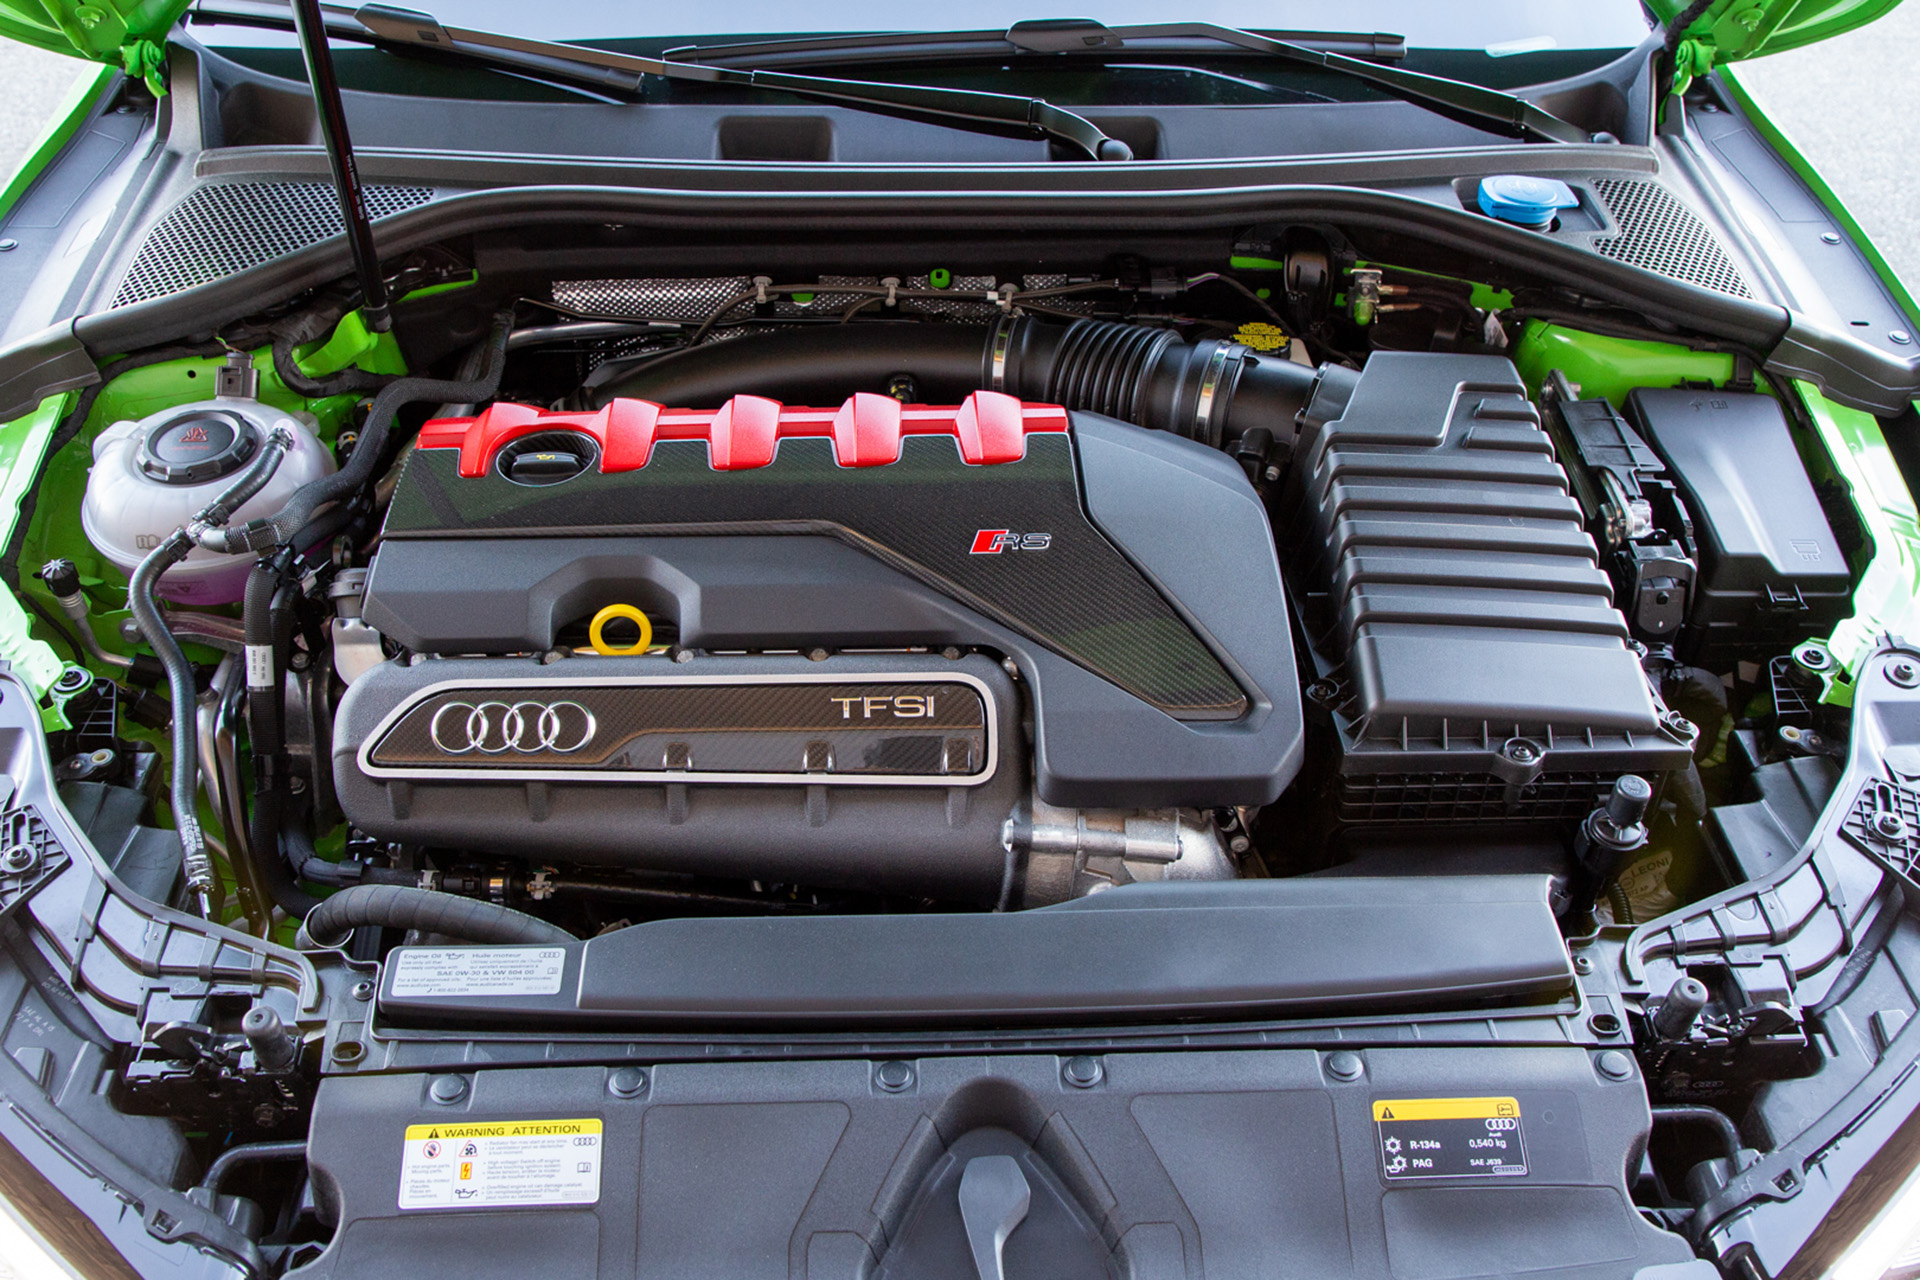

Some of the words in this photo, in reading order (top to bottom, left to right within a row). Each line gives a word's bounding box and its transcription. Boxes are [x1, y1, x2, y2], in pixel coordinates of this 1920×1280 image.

[989, 533, 1052, 550] RS
[831, 695, 935, 719] TFSI
[1631, 857, 1669, 878] LEONI
[444, 1127, 505, 1138] WARNING
[512, 1125, 582, 1134] ATTENTION
[1410, 1140, 1442, 1150] R-134a
[1469, 1139, 1494, 1149] 0,540
[1496, 1138, 1507, 1149] kg
[1412, 1159, 1433, 1168] PAG
